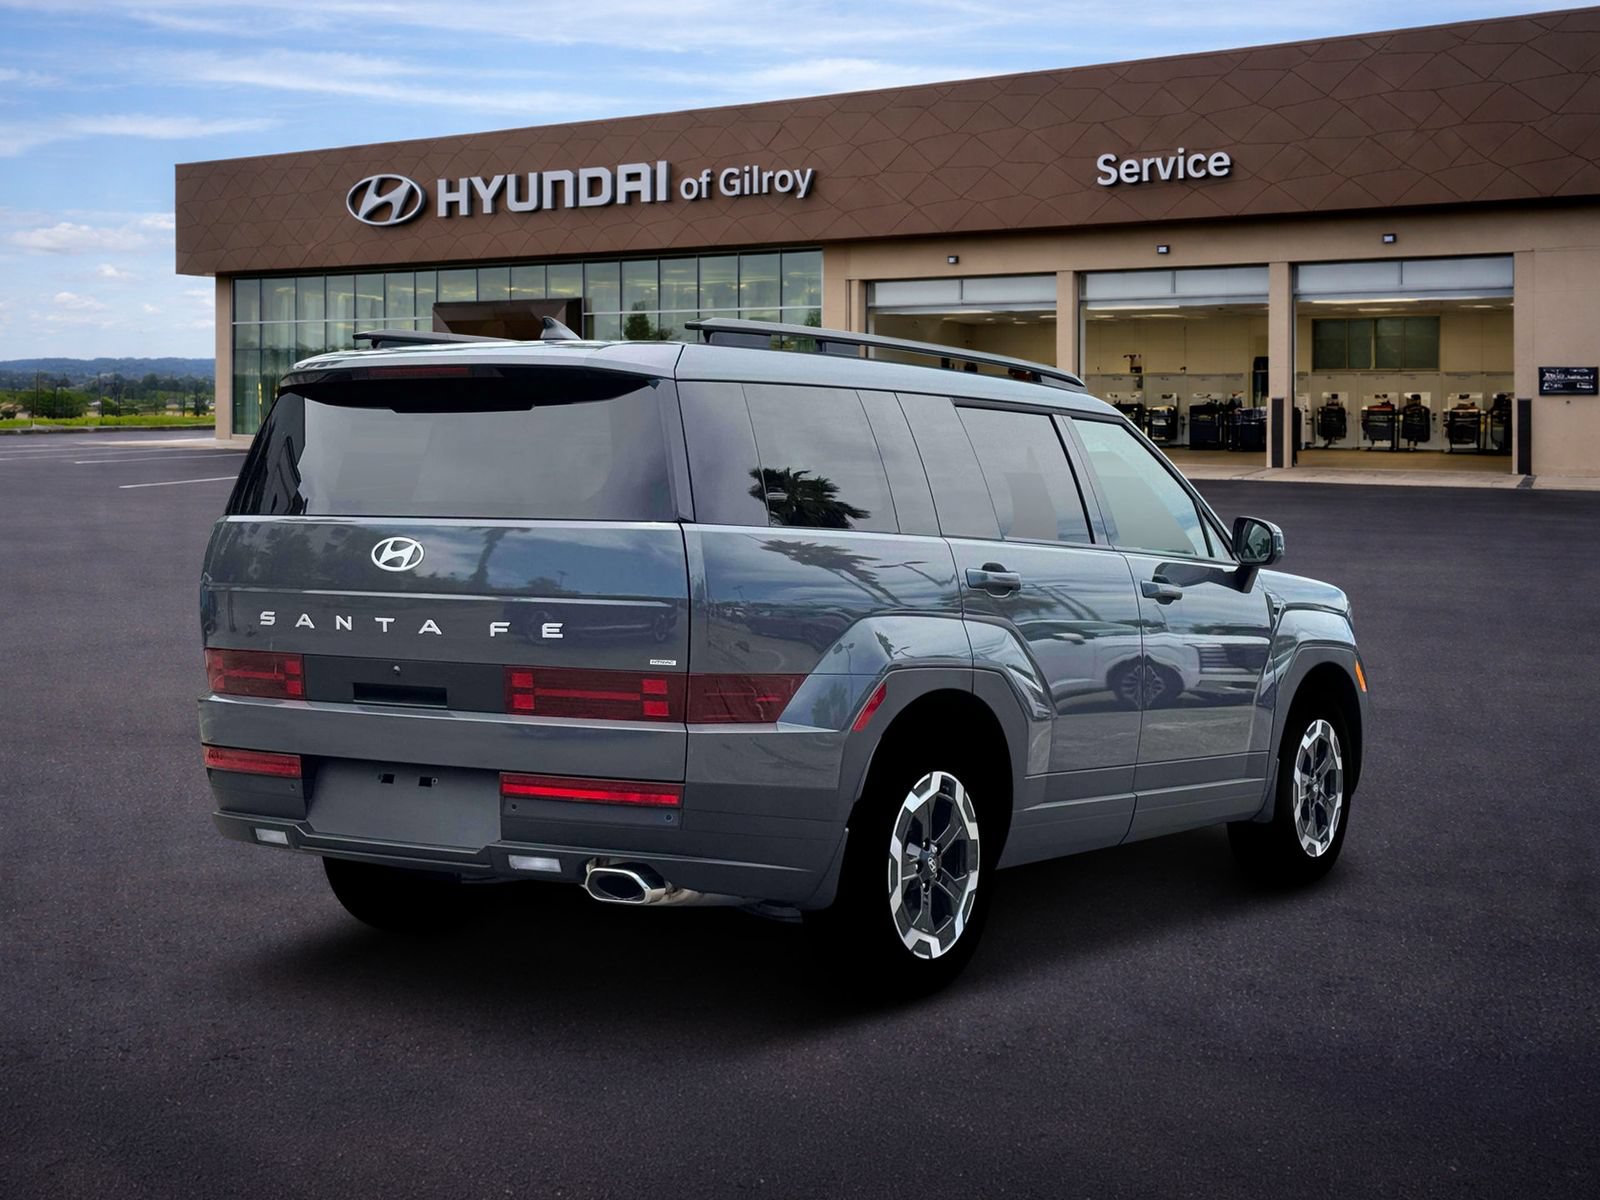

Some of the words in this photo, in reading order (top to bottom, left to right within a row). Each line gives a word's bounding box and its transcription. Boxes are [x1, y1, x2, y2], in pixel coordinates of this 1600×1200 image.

[1096, 147, 1231, 186] Service
[437, 160, 668, 217] HYUNDAI
[680, 168, 712, 200] of
[718, 165, 813, 199] Gilroy
[259, 611, 443, 636] SANTA
[489, 621, 564, 639] FE
